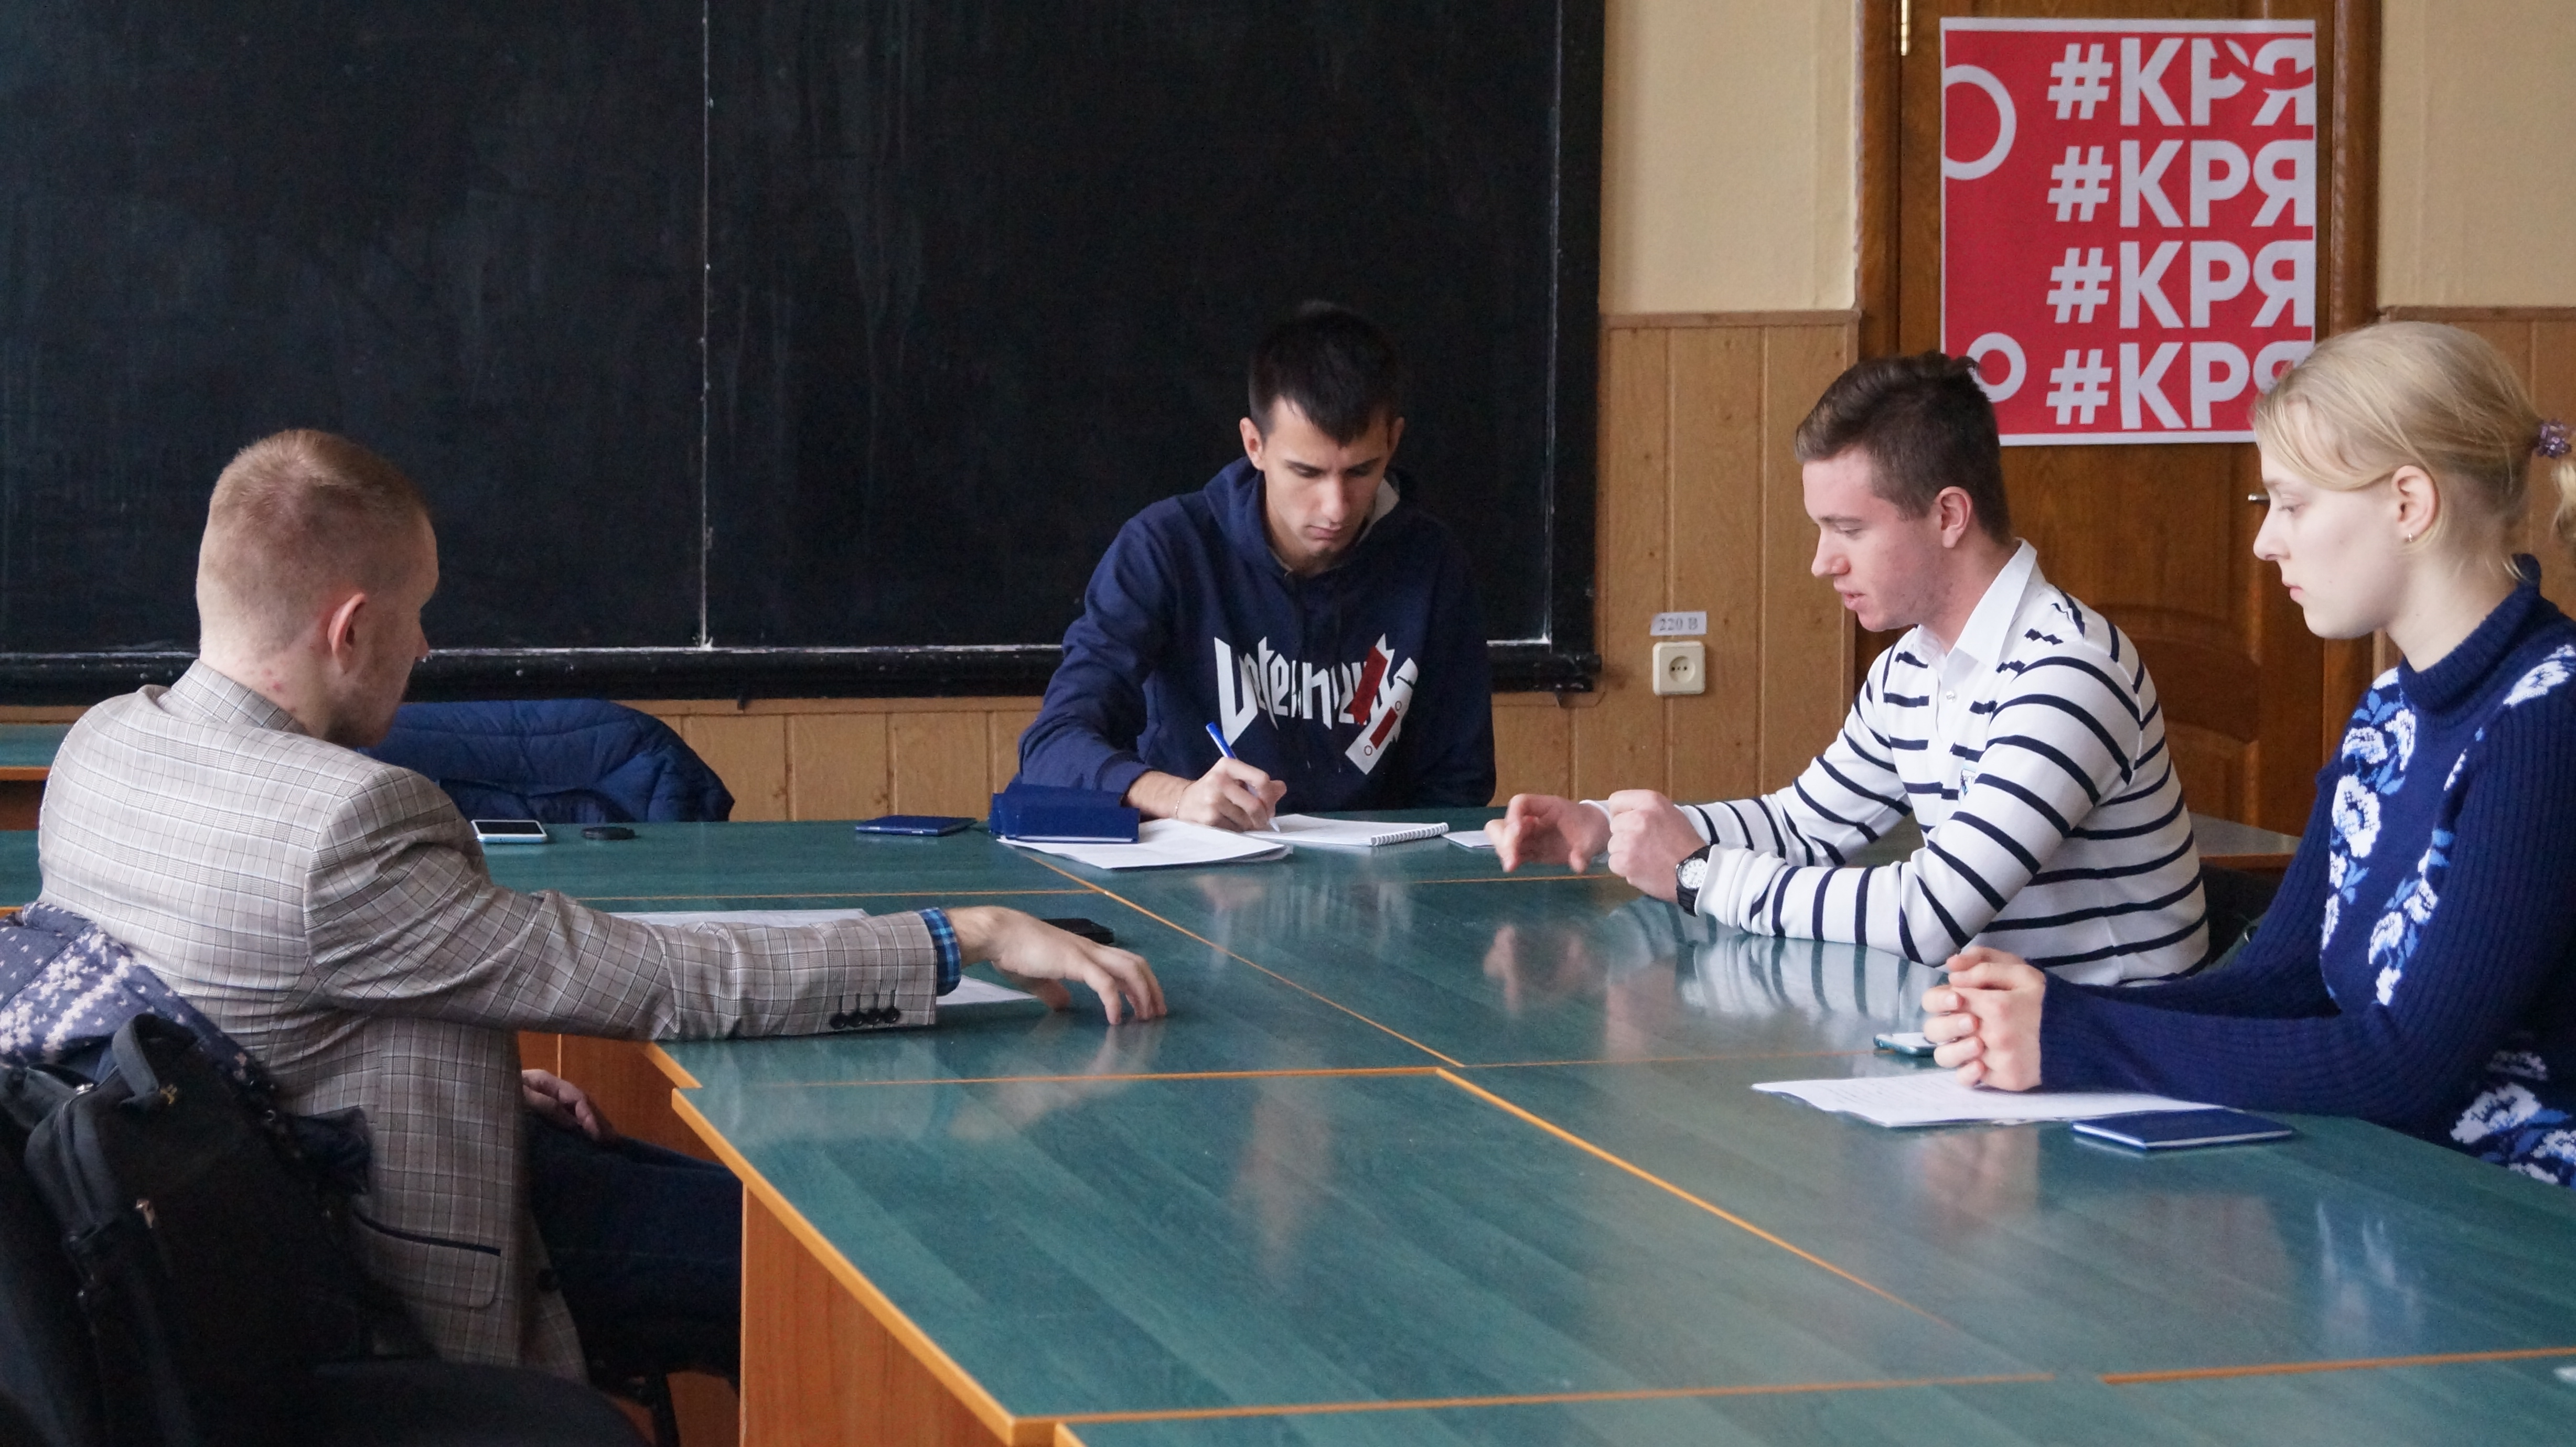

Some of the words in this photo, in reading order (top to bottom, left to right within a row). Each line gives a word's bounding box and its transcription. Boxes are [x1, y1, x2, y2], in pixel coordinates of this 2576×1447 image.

[2047, 37, 2314, 126] #КРЯ
[2047, 139, 2314, 228] #КРЯ
[2046, 240, 2314, 329] #КРЯ
[1659, 618, 1683, 631] 220
